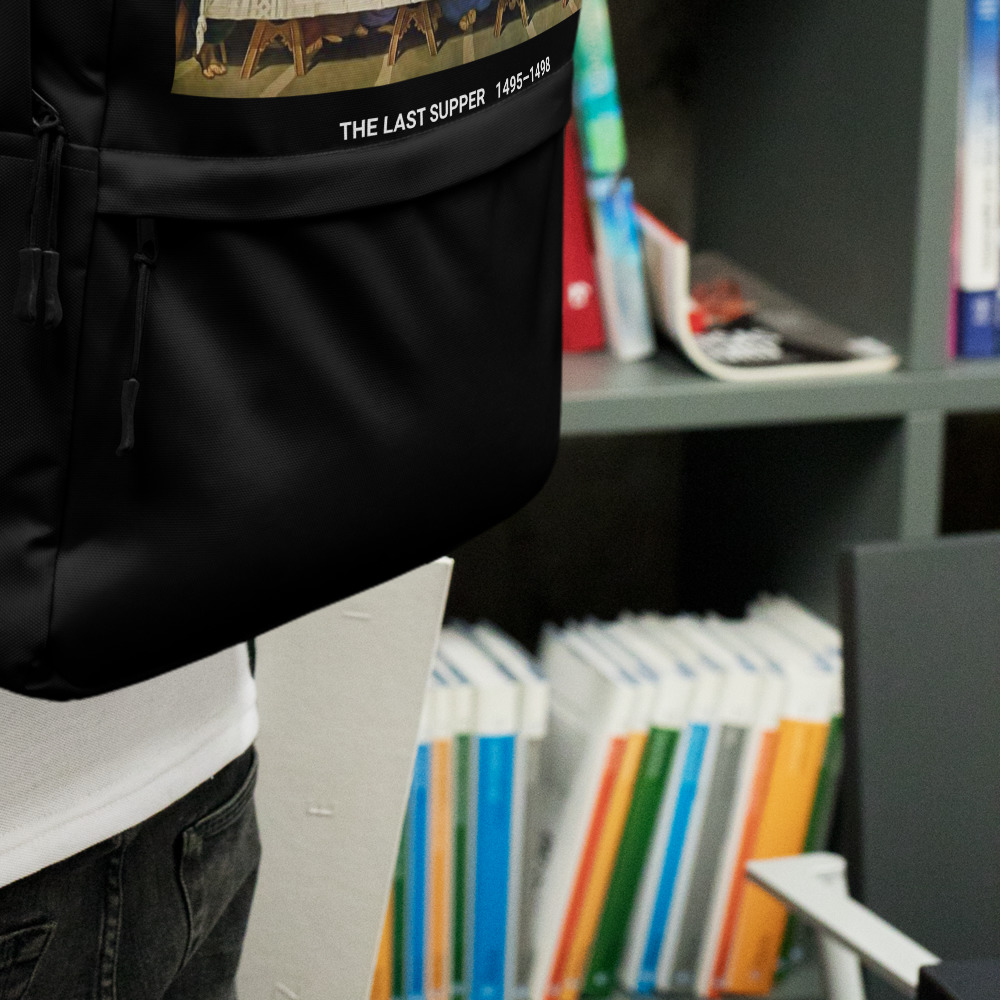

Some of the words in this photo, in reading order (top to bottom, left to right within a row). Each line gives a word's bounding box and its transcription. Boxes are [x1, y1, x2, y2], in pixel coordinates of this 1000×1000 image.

[339, 117, 379, 141] THE
[383, 106, 427, 135] LAST
[429, 87, 486, 123] SUPPER
